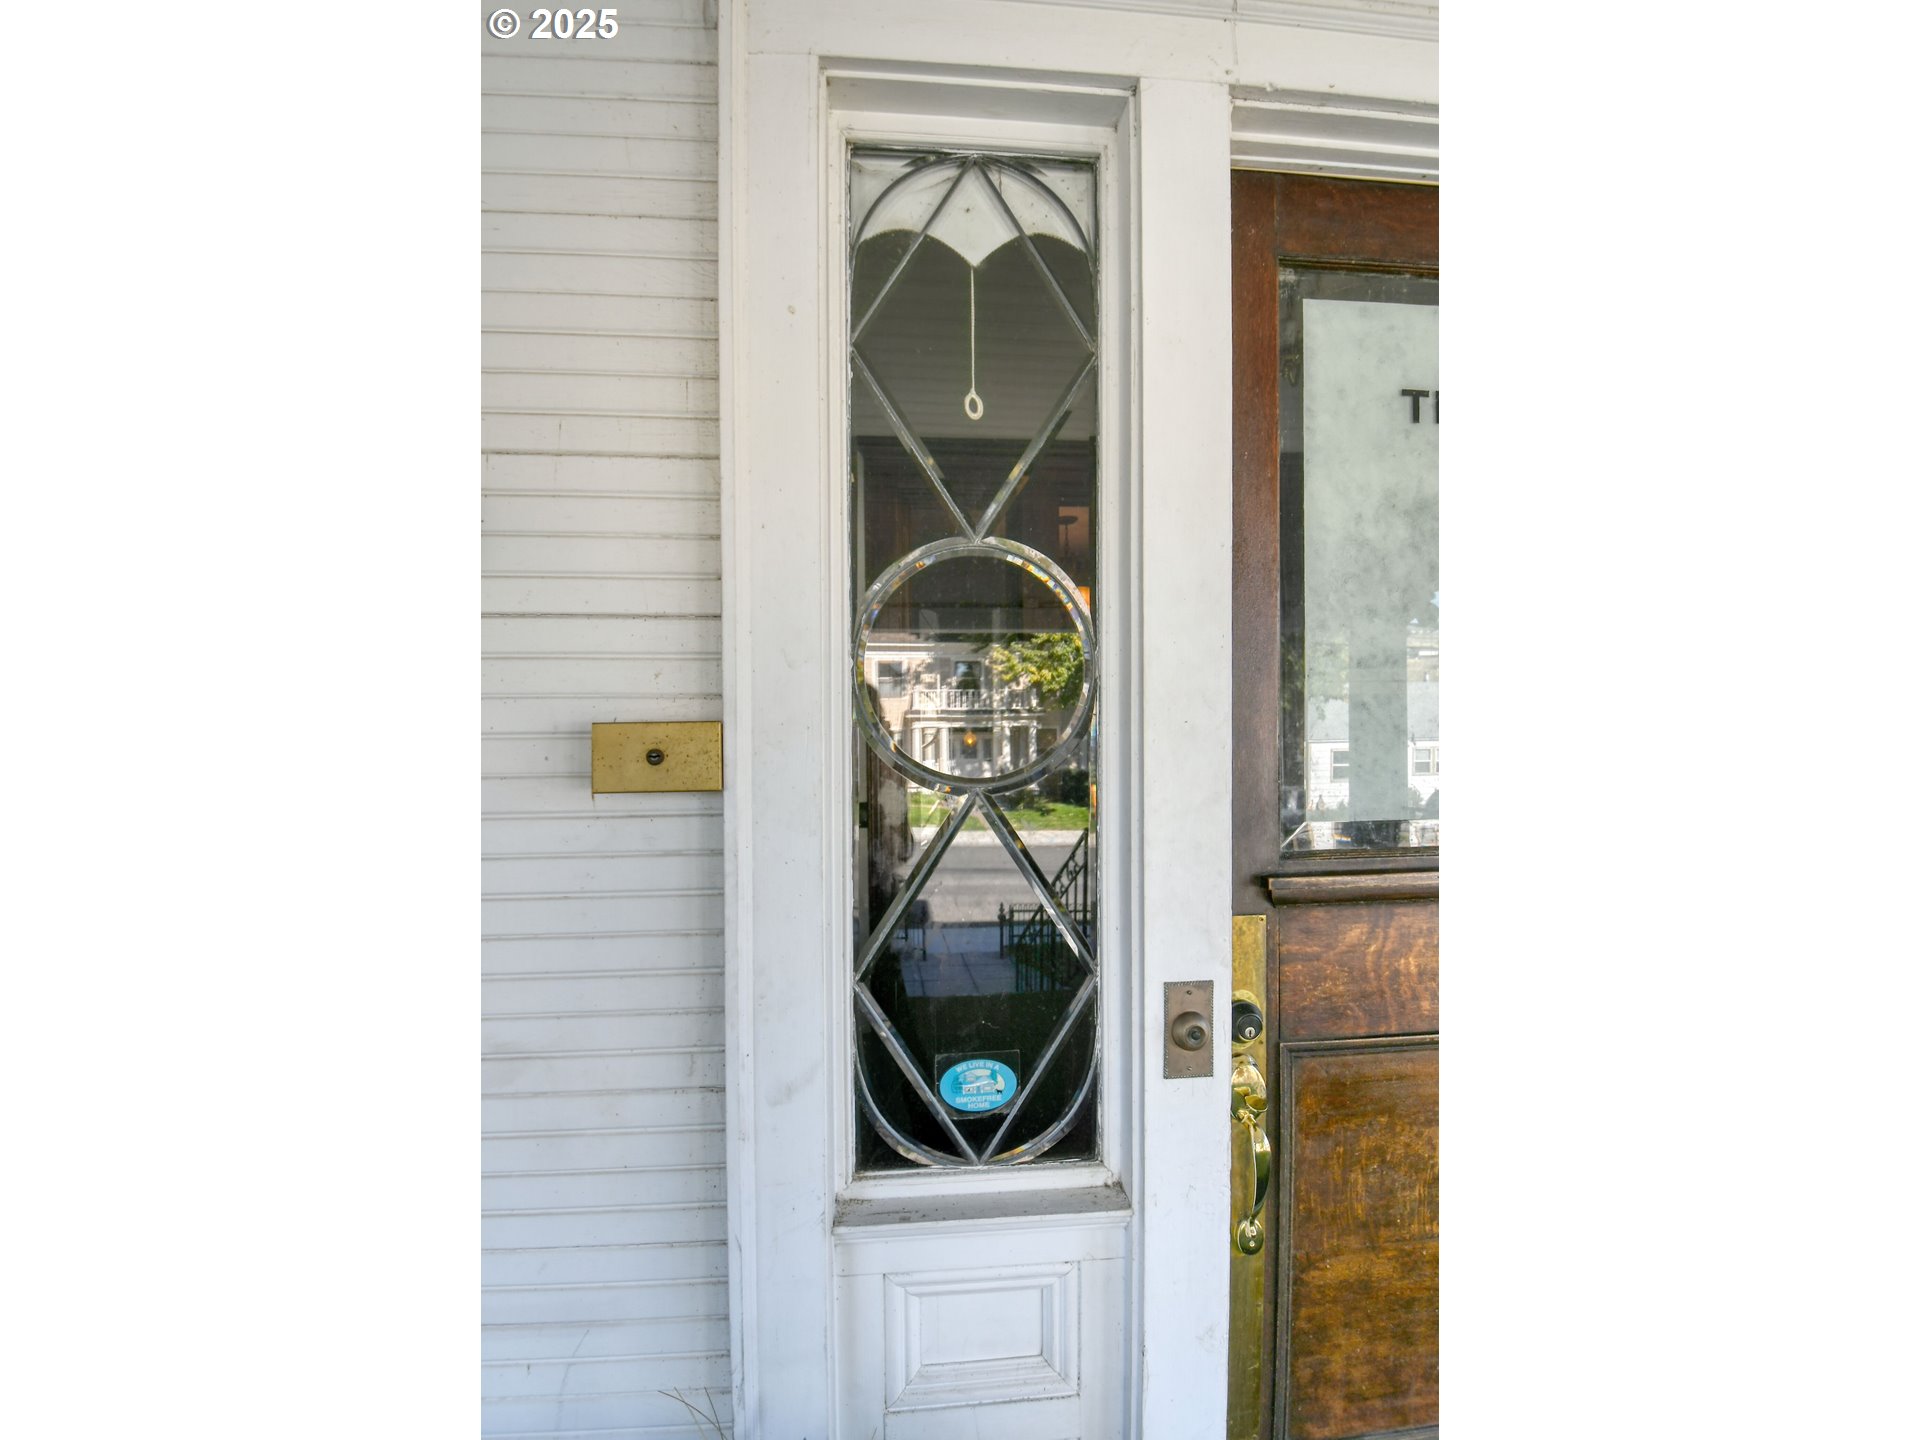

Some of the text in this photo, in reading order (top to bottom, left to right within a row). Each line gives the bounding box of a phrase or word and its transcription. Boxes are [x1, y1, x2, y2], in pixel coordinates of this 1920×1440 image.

[1401, 389, 1439, 424] T
[956, 1064, 968, 1072] WE
[968, 1061, 984, 1069] LIVE
[956, 1094, 1002, 1103] SMOKEFREE
